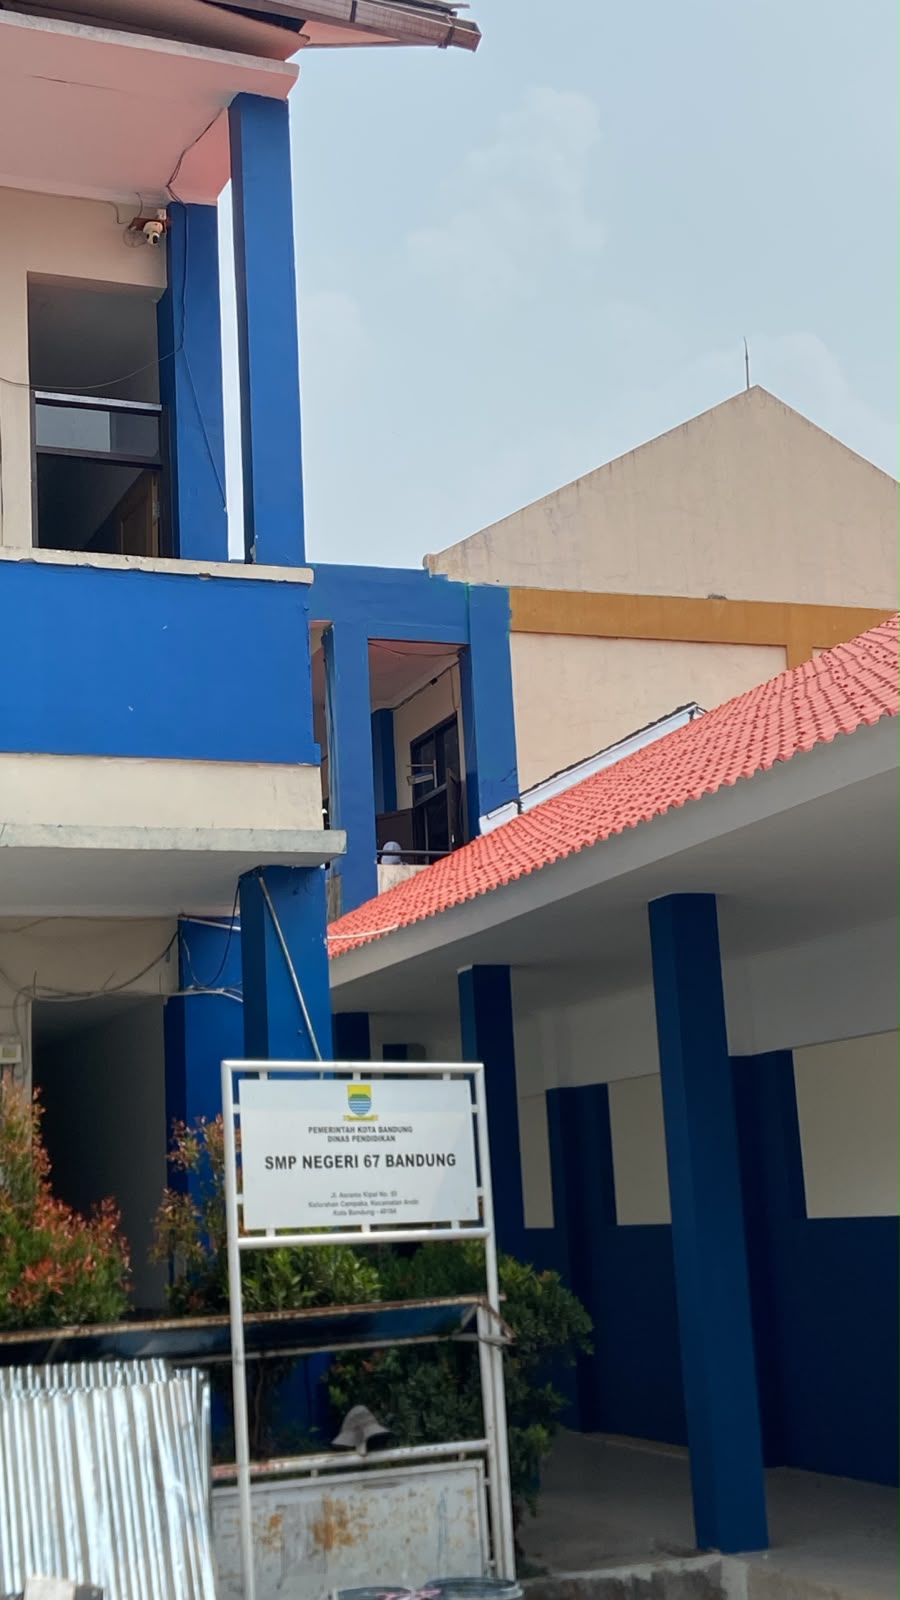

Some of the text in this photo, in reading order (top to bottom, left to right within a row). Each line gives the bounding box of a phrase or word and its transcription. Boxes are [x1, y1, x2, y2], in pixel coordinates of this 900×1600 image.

[308, 1126, 355, 1134] PEMERINTAH
[352, 1134, 396, 1142] PENDIDIKAN
[265, 1153, 456, 1170] SMP NEGERI 67 BANDUNG
[348, 1208, 374, 1216] Bandung
